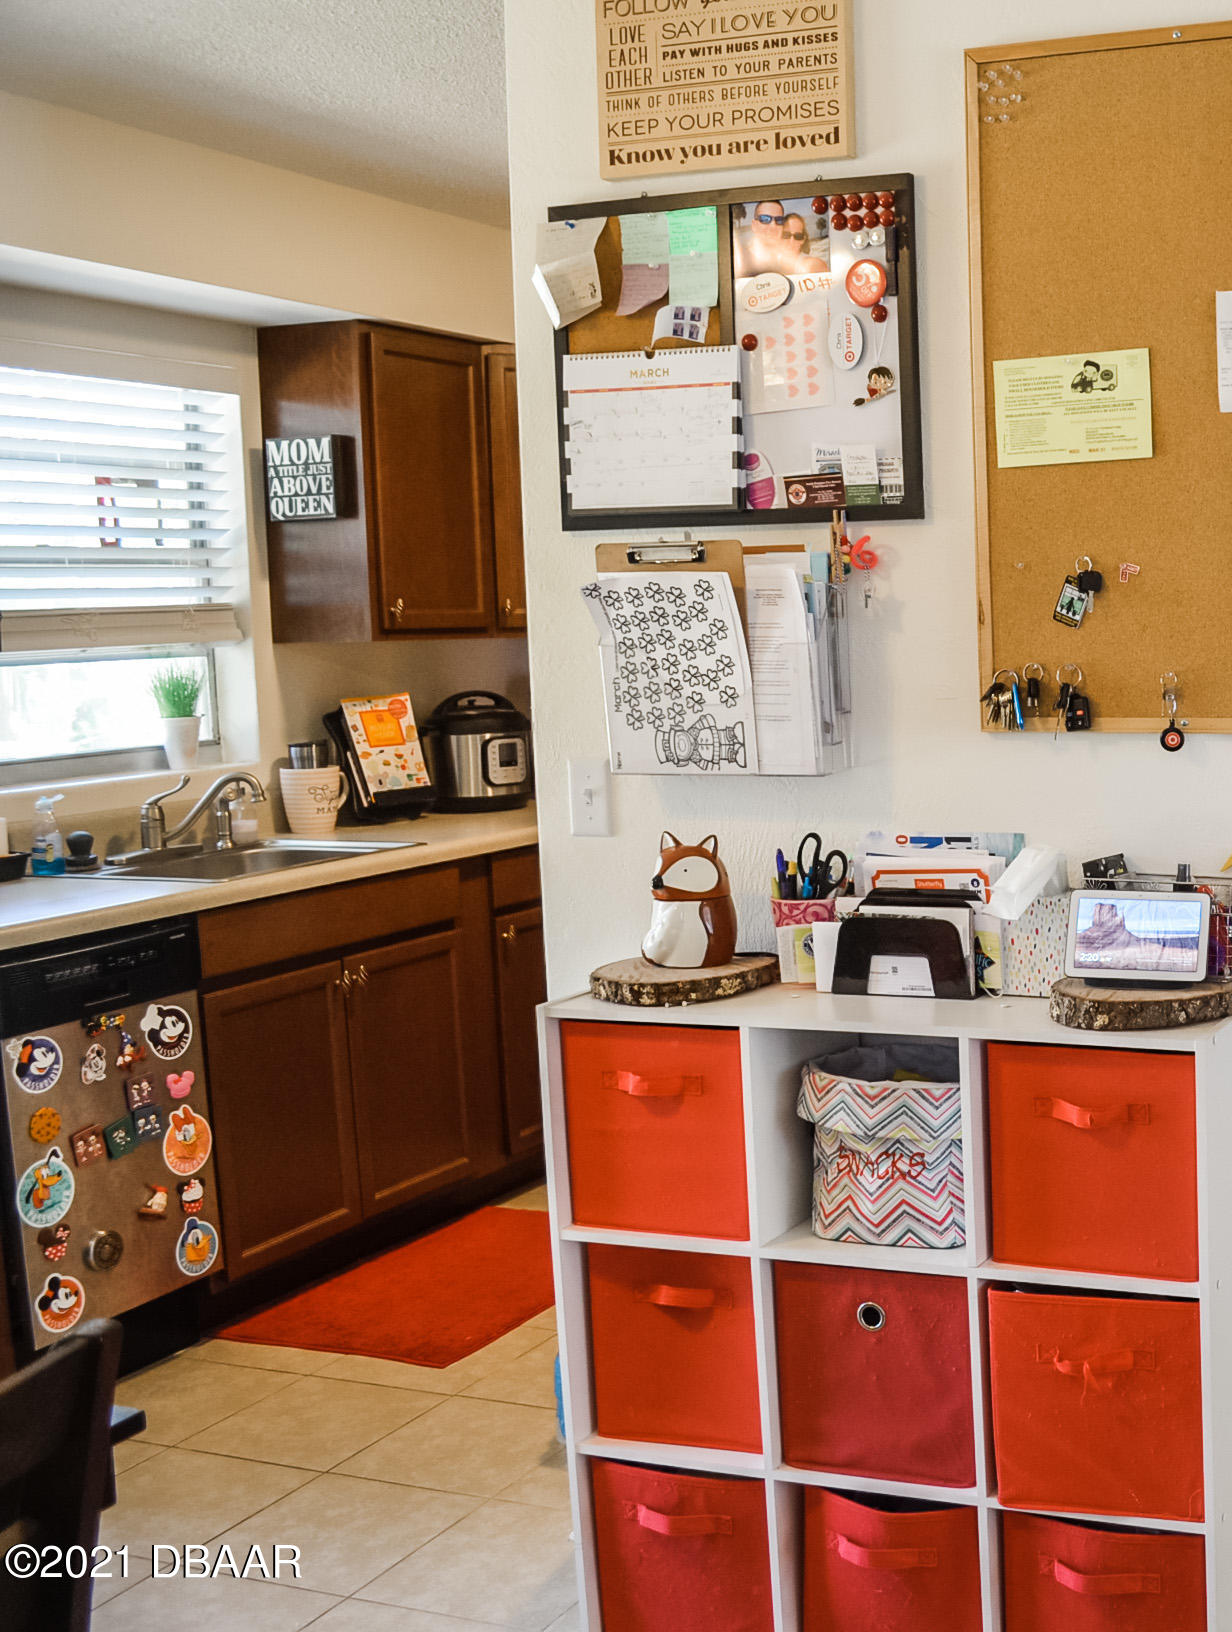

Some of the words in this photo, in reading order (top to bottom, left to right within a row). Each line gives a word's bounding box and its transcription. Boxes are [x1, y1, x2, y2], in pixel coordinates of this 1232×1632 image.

[610, 23, 646, 46] LOVE
[662, 18, 706, 40] SAY
[711, 17, 717, 34] I
[721, 10, 777, 34] LOVE
[782, 4, 838, 26] YOU
[608, 46, 648, 68] EACH
[662, 49, 686, 61] PAY
[689, 44, 722, 58] WITH
[726, 40, 759, 54] HUGS
[762, 37, 789, 50] AND
[792, 31, 839, 46] KISSES
[605, 67, 653, 89] OTHER
[662, 67, 705, 83] LISTEN
[712, 64, 728, 78] TO
[735, 60, 771, 75] YOUR
[778, 52, 838, 70] PARENTS
[605, 97, 641, 113] THINK
[647, 95, 662, 109] OF
[668, 89, 715, 106] OTHERS
[721, 83, 769, 101] BEFORE
[774, 75, 839, 95] YOURSELF
[607, 118, 659, 139] KEEP
[664, 111, 725, 132] YOUR
[731, 99, 840, 126] PROMISES
[608, 147, 675, 166] Know
[679, 143, 722, 165] you
[727, 137, 769, 154] are
[774, 126, 840, 150] loved
[630, 368, 670, 379] MARCH
[266, 436, 332, 466] MOM
[267, 466, 276, 478] A
[278, 465, 306, 477] TITLE
[307, 462, 332, 475] JUST
[270, 474, 334, 497] ABOVE
[271, 494, 335, 520] QUEEN
[612, 677, 623, 712] March
[1079, 952, 1099, 962] 2:20
[157, 1033, 190, 1057] PASSHOLDER
[23, 1064, 60, 1090] PASSHOLDER
[836, 1146, 927, 1181] SNACKS
